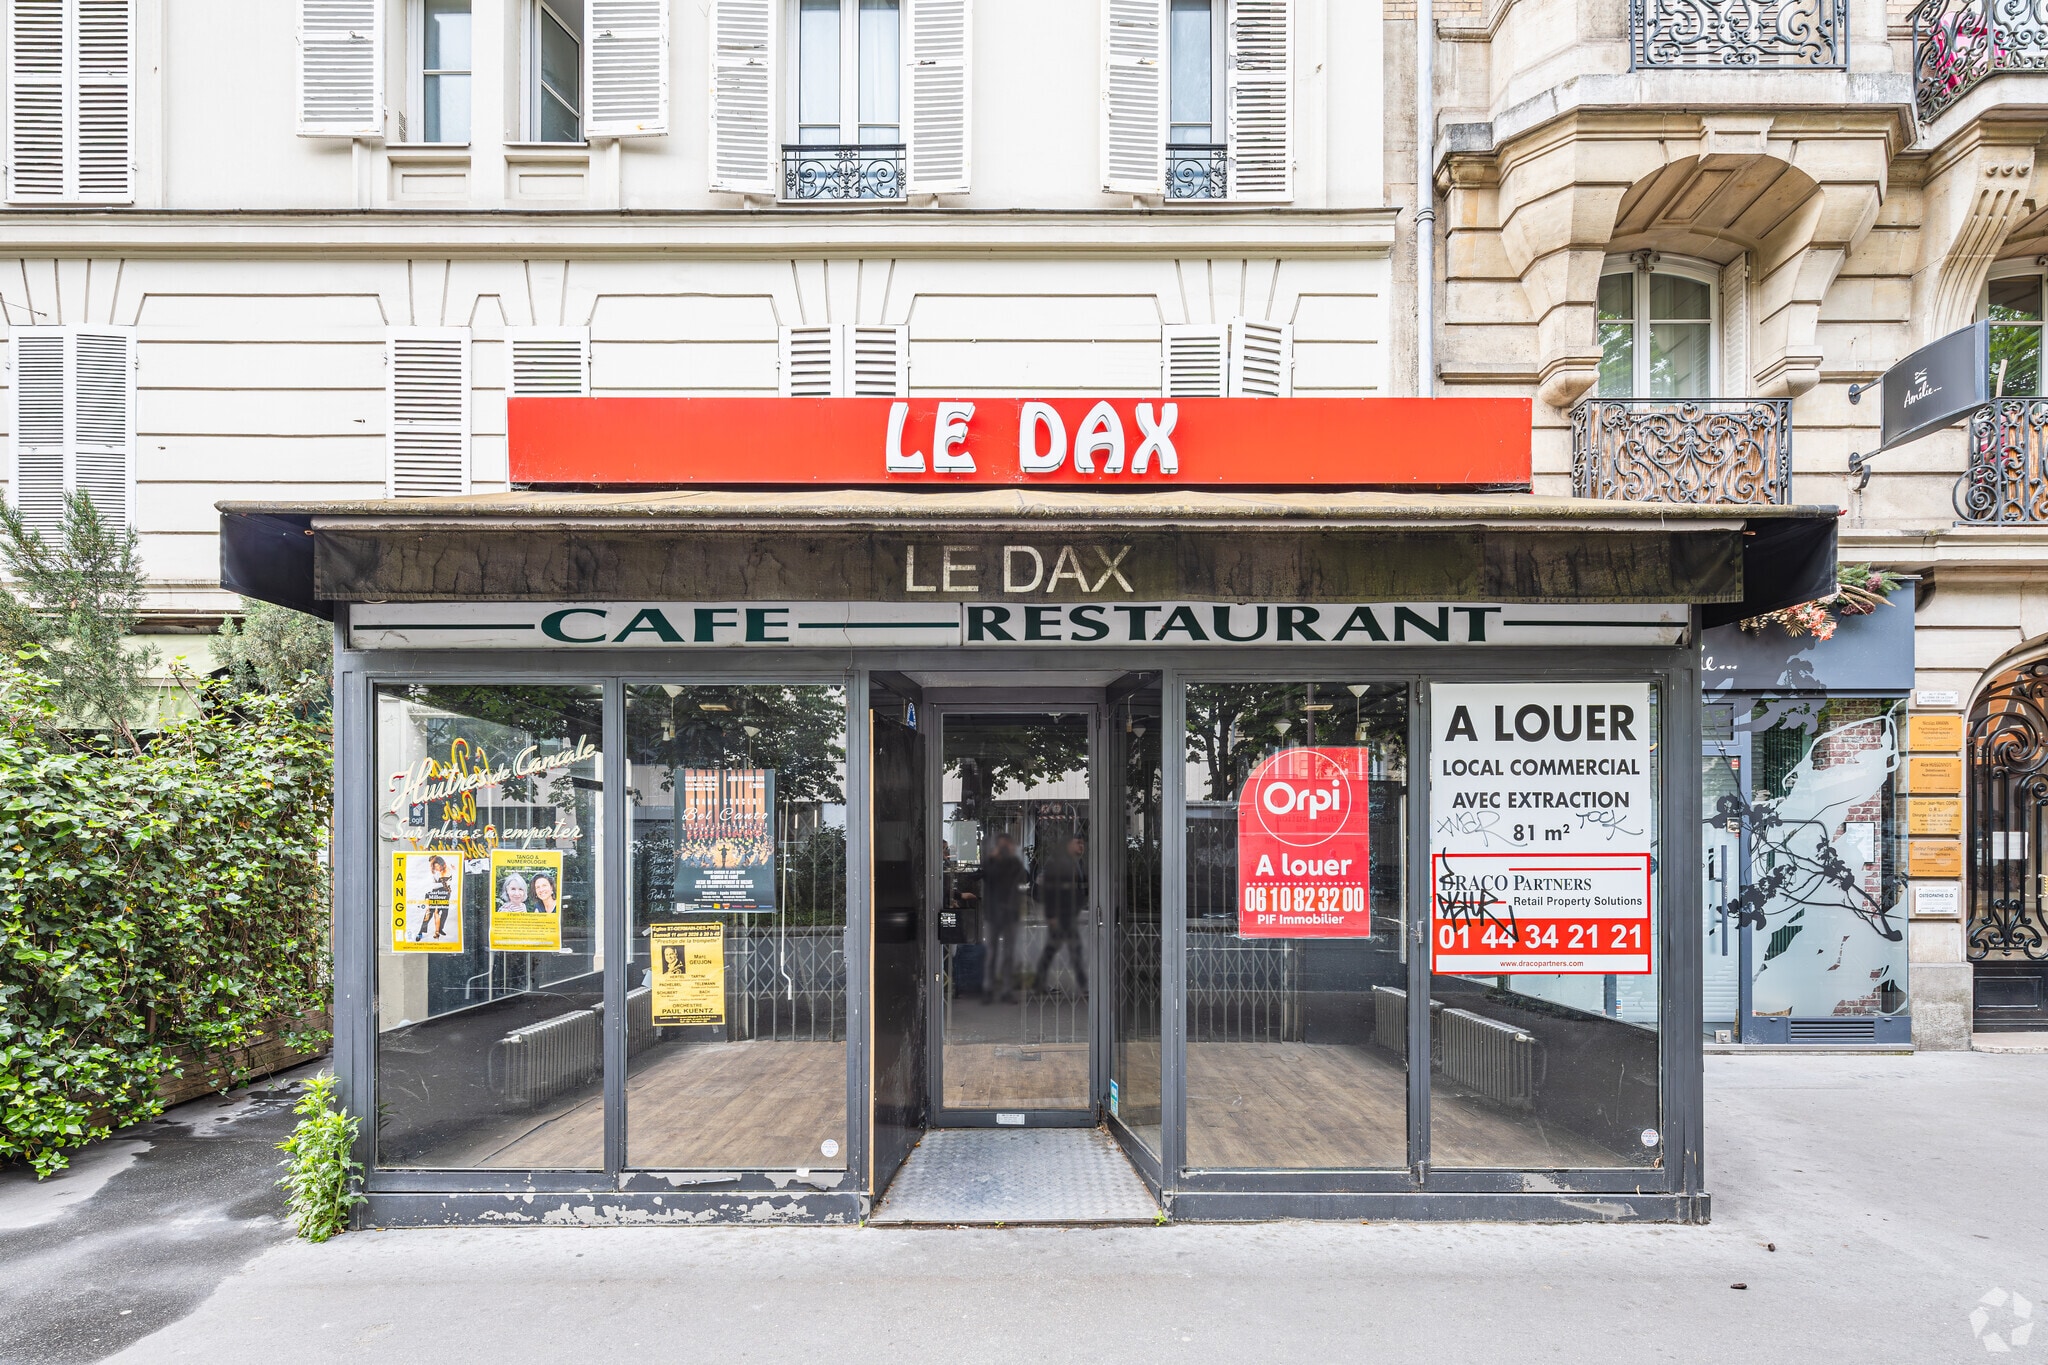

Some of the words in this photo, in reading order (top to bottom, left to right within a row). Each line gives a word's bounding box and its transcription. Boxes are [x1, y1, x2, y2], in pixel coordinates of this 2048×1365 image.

[886, 401, 977, 474] LE
[1019, 400, 1179, 475] DAX
[905, 545, 979, 592] LE
[1003, 544, 1134, 593] DAX
[541, 608, 790, 643] CAFE
[966, 605, 1502, 642] RESTAURANT
[1444, 705, 1478, 742] A
[1494, 704, 1637, 742] LOUER
[487, 763, 511, 785] de
[512, 734, 597, 779] Cancale
[1442, 759, 1504, 776] LOCAL
[1510, 759, 1640, 776] COMMERCIAL
[1263, 779, 1340, 820] Orpi
[1452, 792, 1500, 809] AVEC
[1508, 791, 1629, 809] EXTRACTION
[682, 807, 712, 821] Bel
[719, 807, 769, 821] Canto
[391, 818, 424, 840] Sur
[425, 820, 469, 850] place
[502, 818, 584, 850] emporter
[1513, 824, 1535, 841] 81
[1255, 854, 1275, 877] A
[1281, 853, 1352, 877] louer
[395, 857, 405, 927] TANGO
[1513, 896, 1544, 906] Retail
[1547, 896, 1591, 908] Property
[1594, 896, 1643, 906] Solutions
[1257, 914, 1276, 925] PIF
[1279, 914, 1344, 925] Immobilier
[1439, 925, 1469, 949] 01
[1481, 924, 1516, 949] 44
[1525, 924, 1559, 949] 34
[1567, 924, 1598, 949] 21
[1610, 924, 1642, 949] 21
[1500, 959, 1584, 968] www.dracopartners.com
